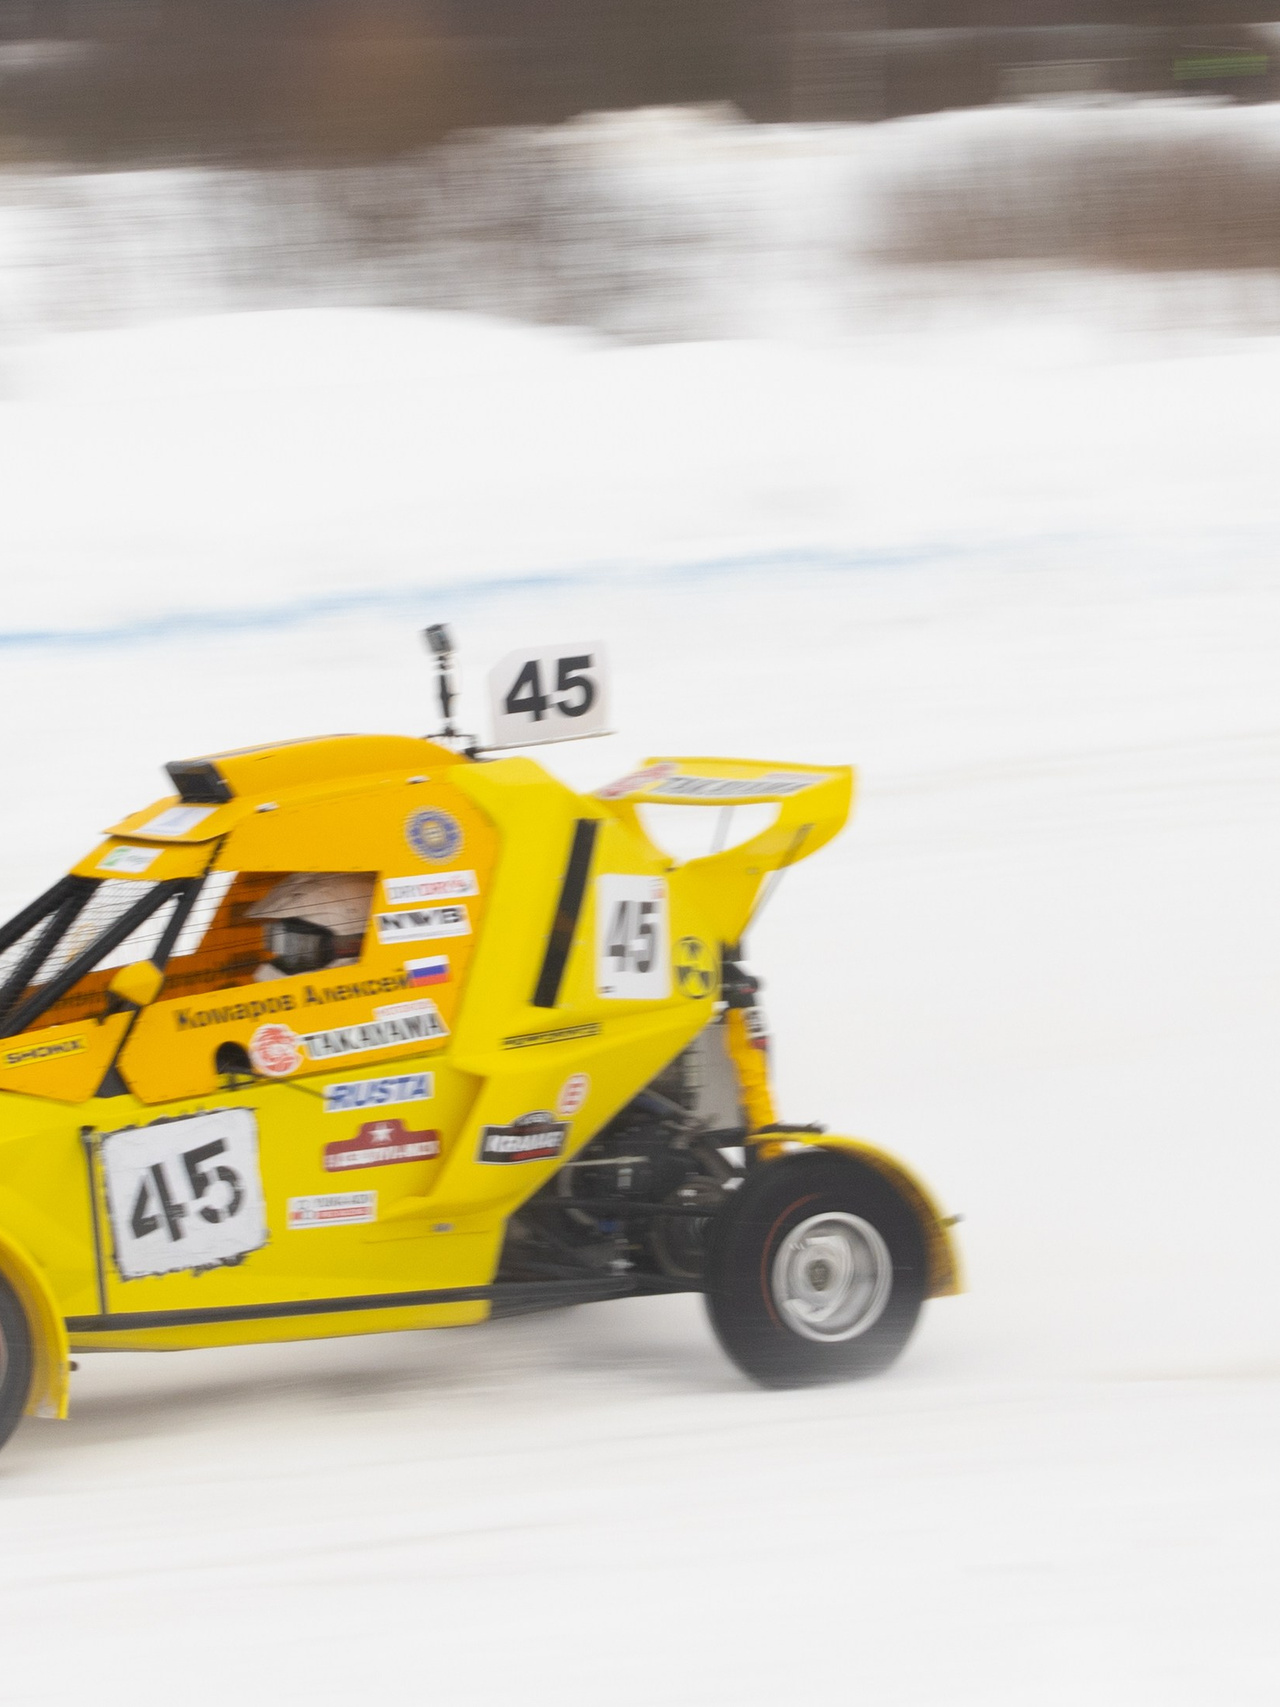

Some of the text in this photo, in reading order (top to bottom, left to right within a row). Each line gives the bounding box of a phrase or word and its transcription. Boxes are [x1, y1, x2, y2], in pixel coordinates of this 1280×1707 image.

[505, 653, 595, 723] 45
[605, 899, 659, 973] 45
[173, 992, 297, 1031] Комаров
[302, 967, 412, 1006] Алексей
[301, 1011, 444, 1057] TAKAYAMA
[327, 1074, 433, 1112] RUSTA
[131, 1136, 244, 1242] 45
